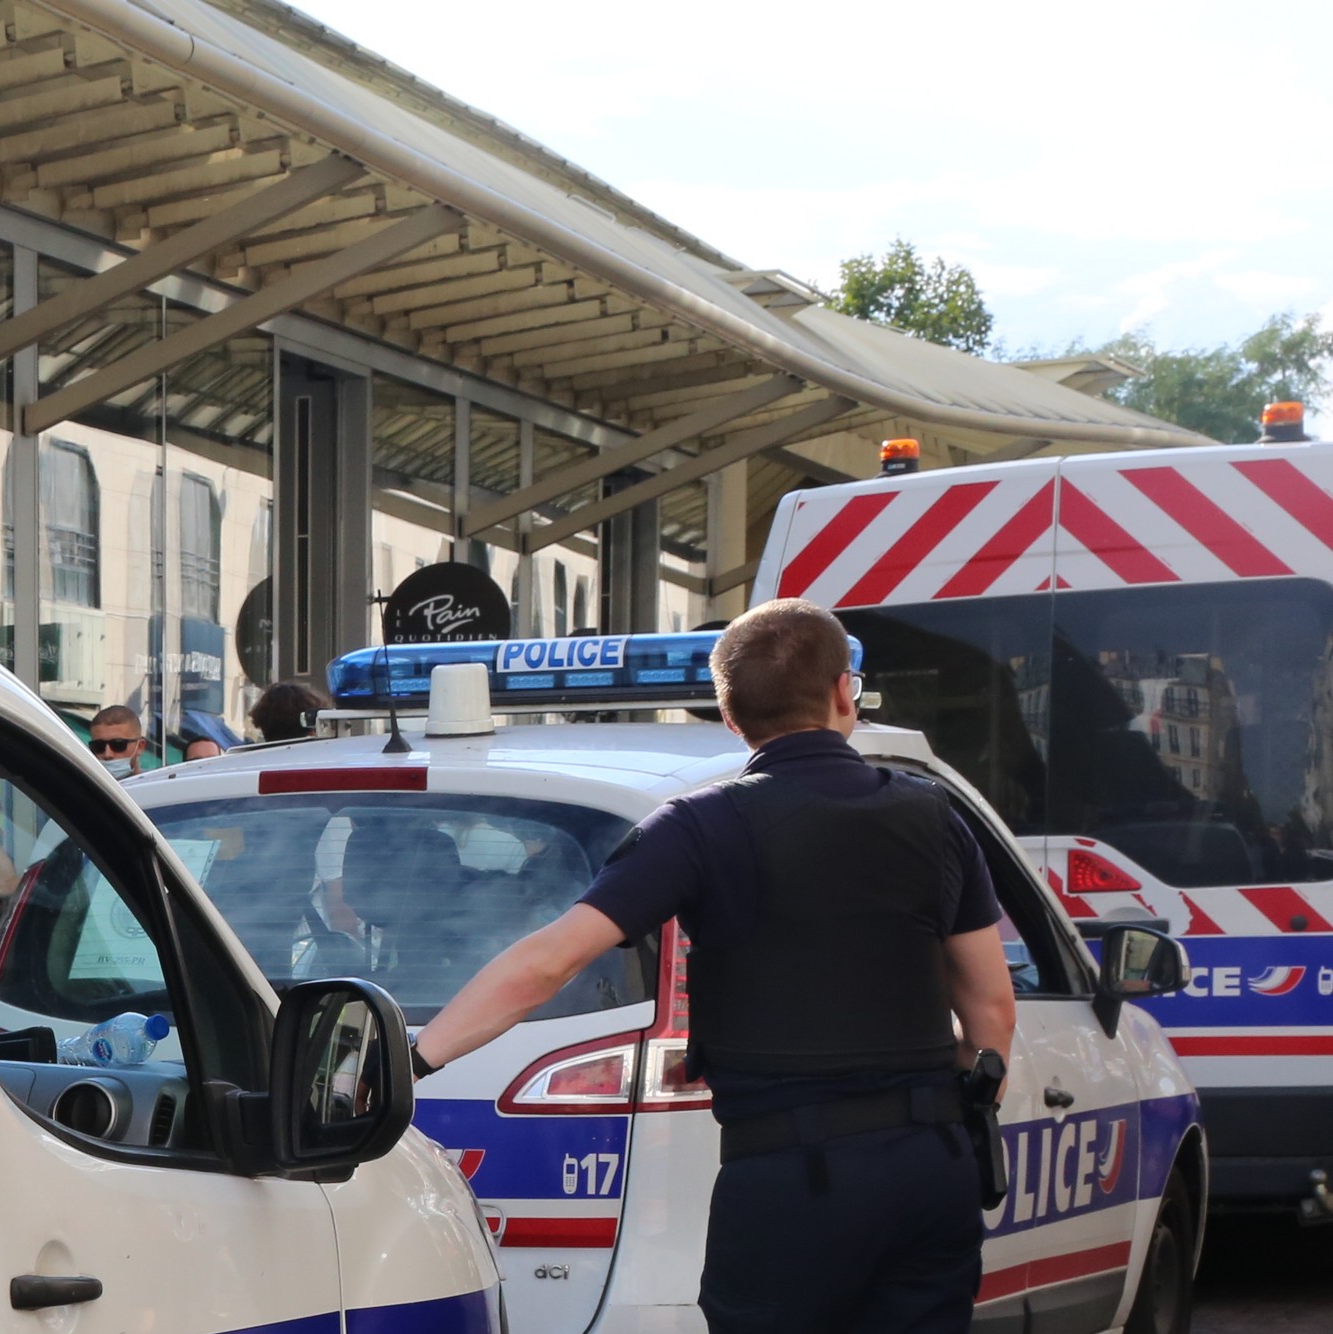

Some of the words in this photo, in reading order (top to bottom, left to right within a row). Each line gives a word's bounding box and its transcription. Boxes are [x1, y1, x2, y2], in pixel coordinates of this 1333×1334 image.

[408, 594, 480, 633] Pain
[503, 638, 623, 671] POLICE
[580, 1153, 619, 1195] 17
[982, 1119, 1097, 1231] LICE
